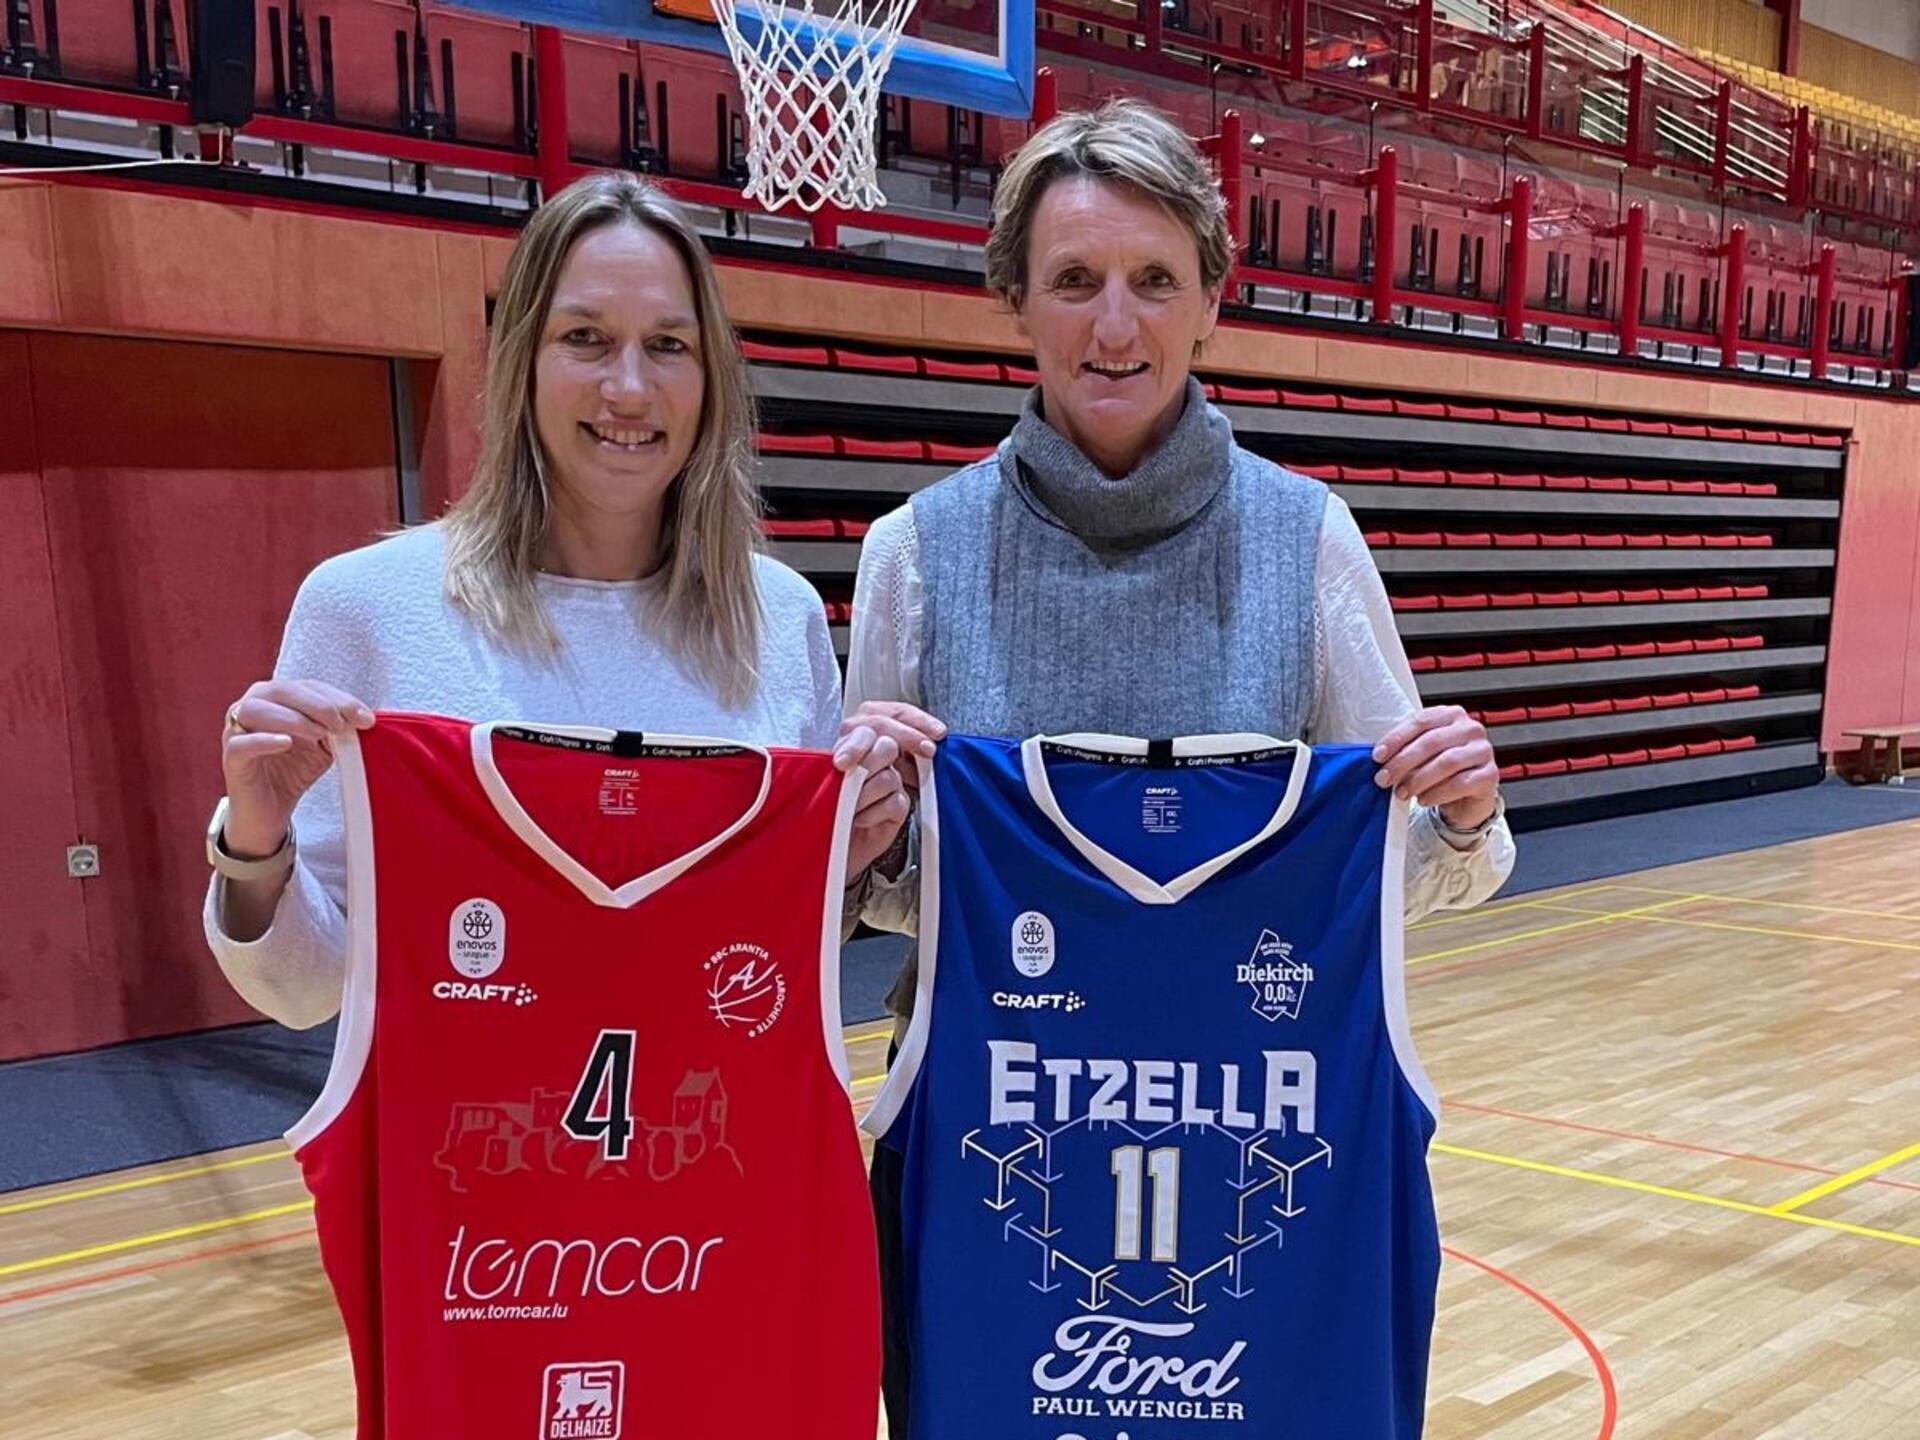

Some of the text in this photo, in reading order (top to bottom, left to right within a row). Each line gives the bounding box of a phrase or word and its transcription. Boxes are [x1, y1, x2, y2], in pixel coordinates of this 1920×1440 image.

[604, 768, 632, 777] CRAFT
[1145, 787, 1172, 795] CRAFT
[456, 940, 497, 951] enovos
[710, 943, 769, 964] BBC ARANTIA
[1017, 946, 1049, 954] enovos
[1236, 962, 1314, 982] Diekirch
[432, 981, 516, 1002] CRAFT
[992, 991, 1065, 1009] CRAFT
[755, 973, 786, 1034] LAROCHETTE
[560, 1029, 637, 1161] 4
[1111, 1146, 1180, 1262] 11
[445, 1225, 724, 1300] tomcar
[442, 1302, 569, 1322] www.tomcar.lu
[1032, 1314, 1247, 1398] Ford
[1032, 1397, 1244, 1420] PAUL WENGLER
[550, 1418, 612, 1439] DELHAIZE
